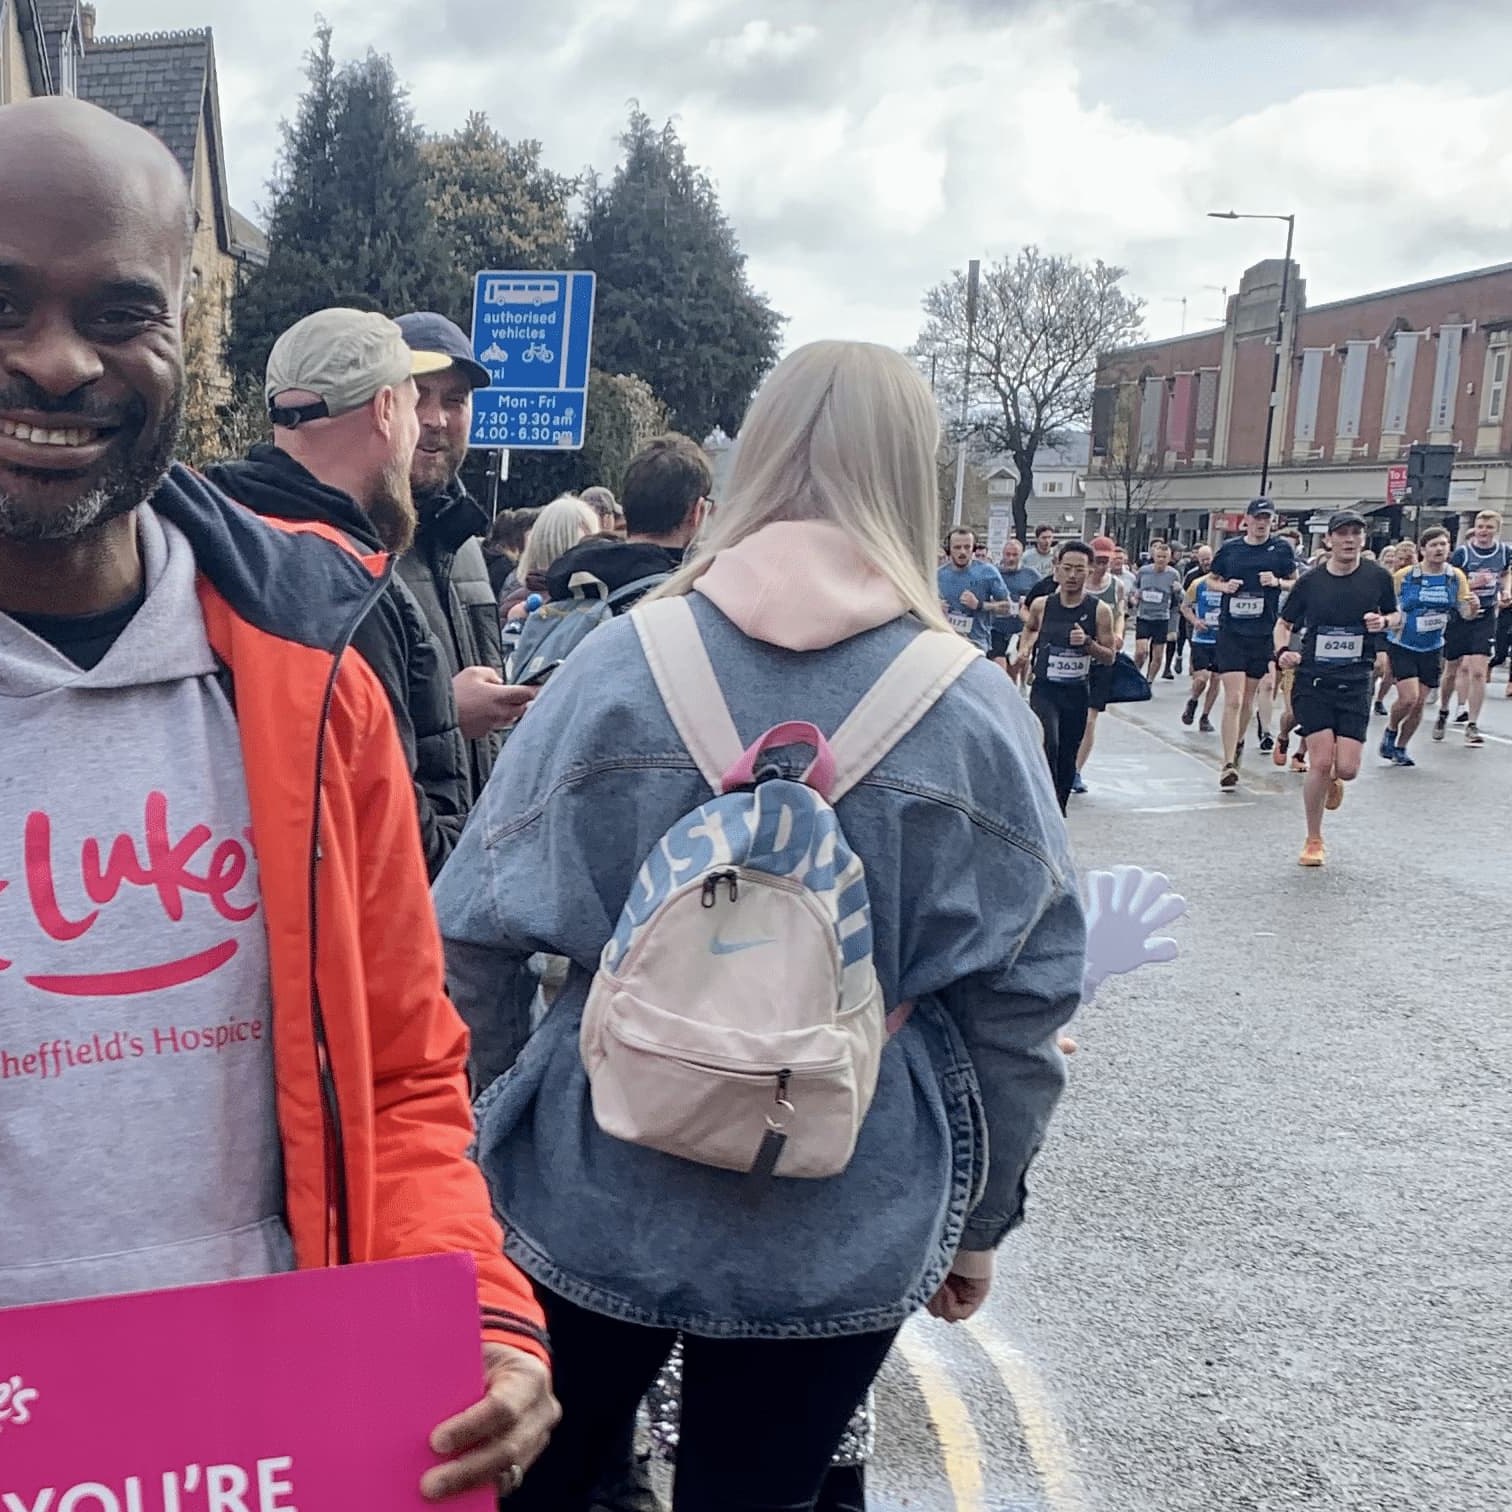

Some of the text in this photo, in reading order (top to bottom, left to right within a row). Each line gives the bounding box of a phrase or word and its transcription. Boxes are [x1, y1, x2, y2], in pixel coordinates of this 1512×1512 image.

[483, 311, 557, 325] authorised
[491, 326, 546, 340] vehicles
[498, 395, 528, 409] Mon
[538, 395, 556, 409] Fri
[478, 412, 508, 426] 7.30
[518, 412, 550, 426] 9.30
[552, 414, 574, 426] am
[475, 427, 508, 440] 4.00
[518, 427, 550, 441] 6.30
[1324, 639, 1354, 650] 6248
[24, 790, 259, 942] Luke
[153, 1015, 263, 1057] Hospice
